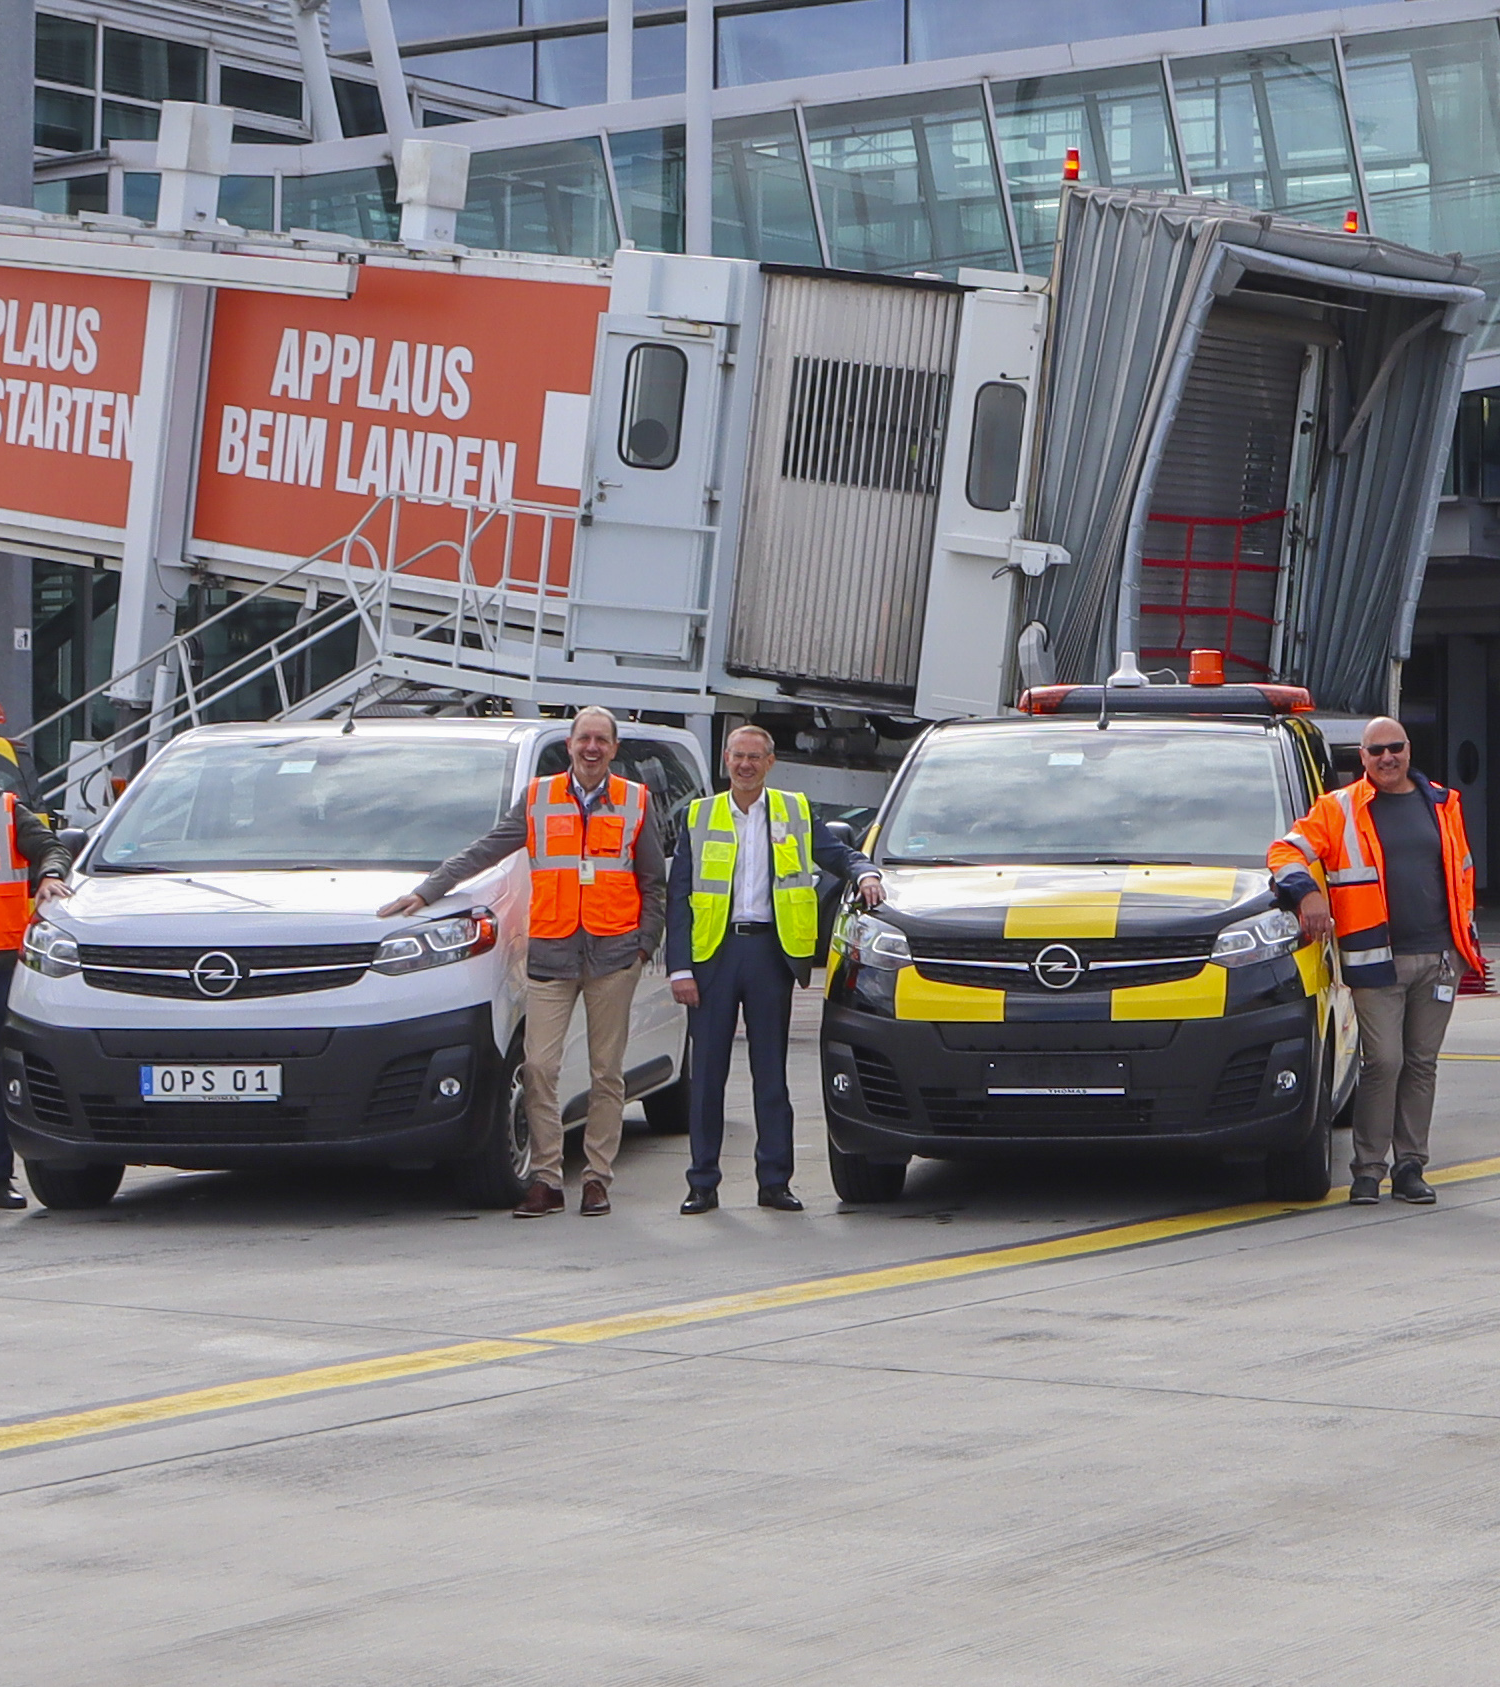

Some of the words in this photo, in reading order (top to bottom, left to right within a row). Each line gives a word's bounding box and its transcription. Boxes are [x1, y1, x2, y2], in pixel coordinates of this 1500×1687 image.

[270, 327, 474, 421] APPLAUS
[217, 404, 328, 489] BEIM
[335, 420, 518, 516] LANDEN
[161, 1070, 216, 1093] OPS
[233, 1069, 269, 1092] 01
